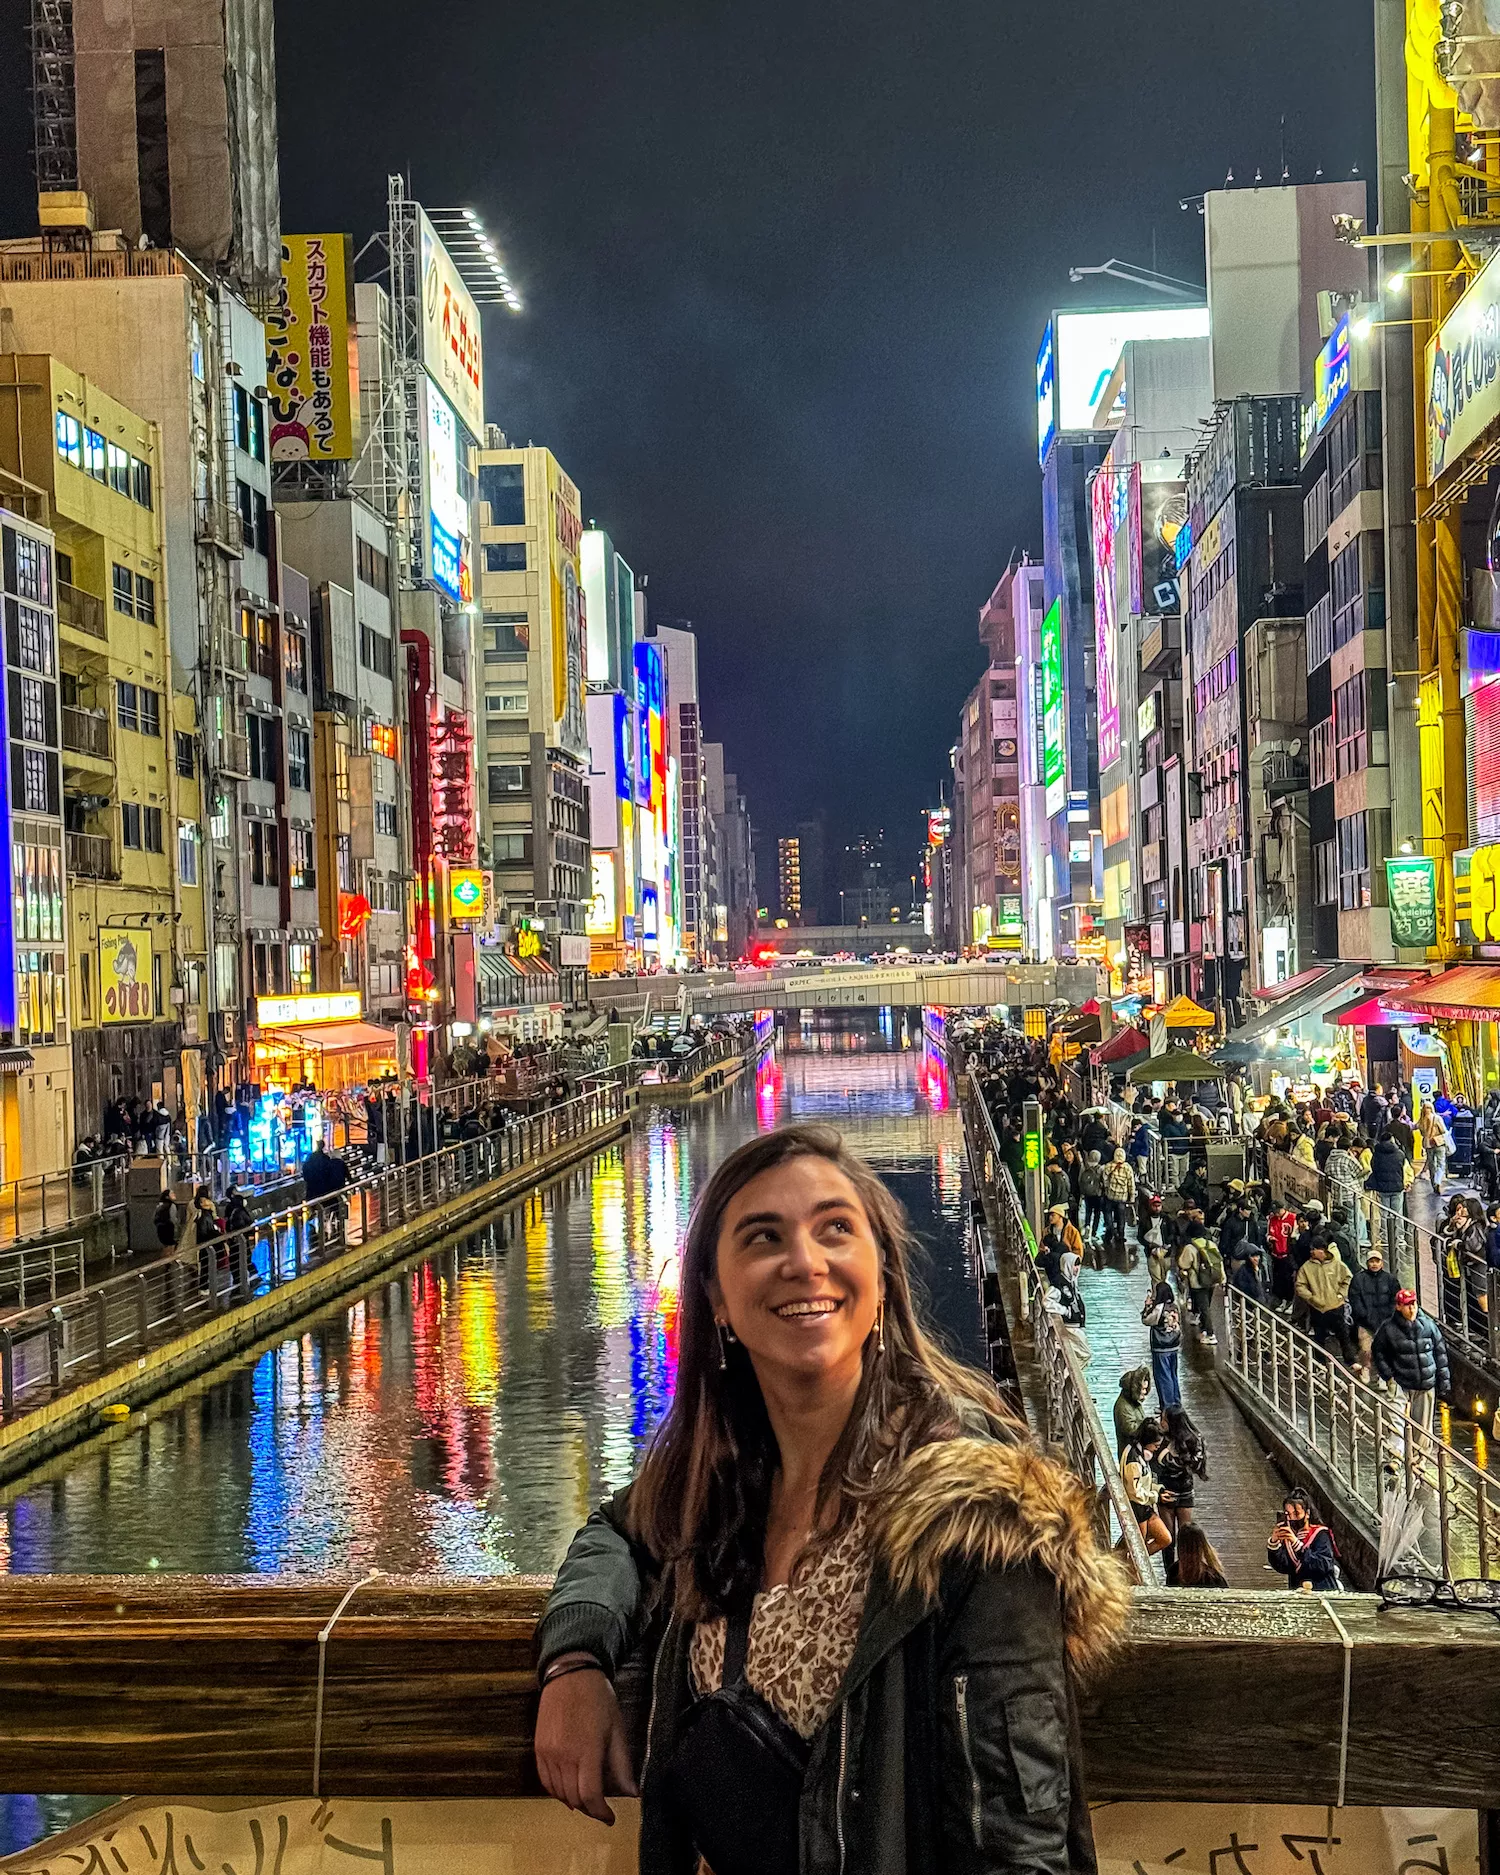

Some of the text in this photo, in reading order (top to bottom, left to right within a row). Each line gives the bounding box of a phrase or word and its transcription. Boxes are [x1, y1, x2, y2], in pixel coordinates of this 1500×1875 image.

[306, 240, 332, 452] スカウト機能もあるで
[1392, 870, 1430, 907] 薬
